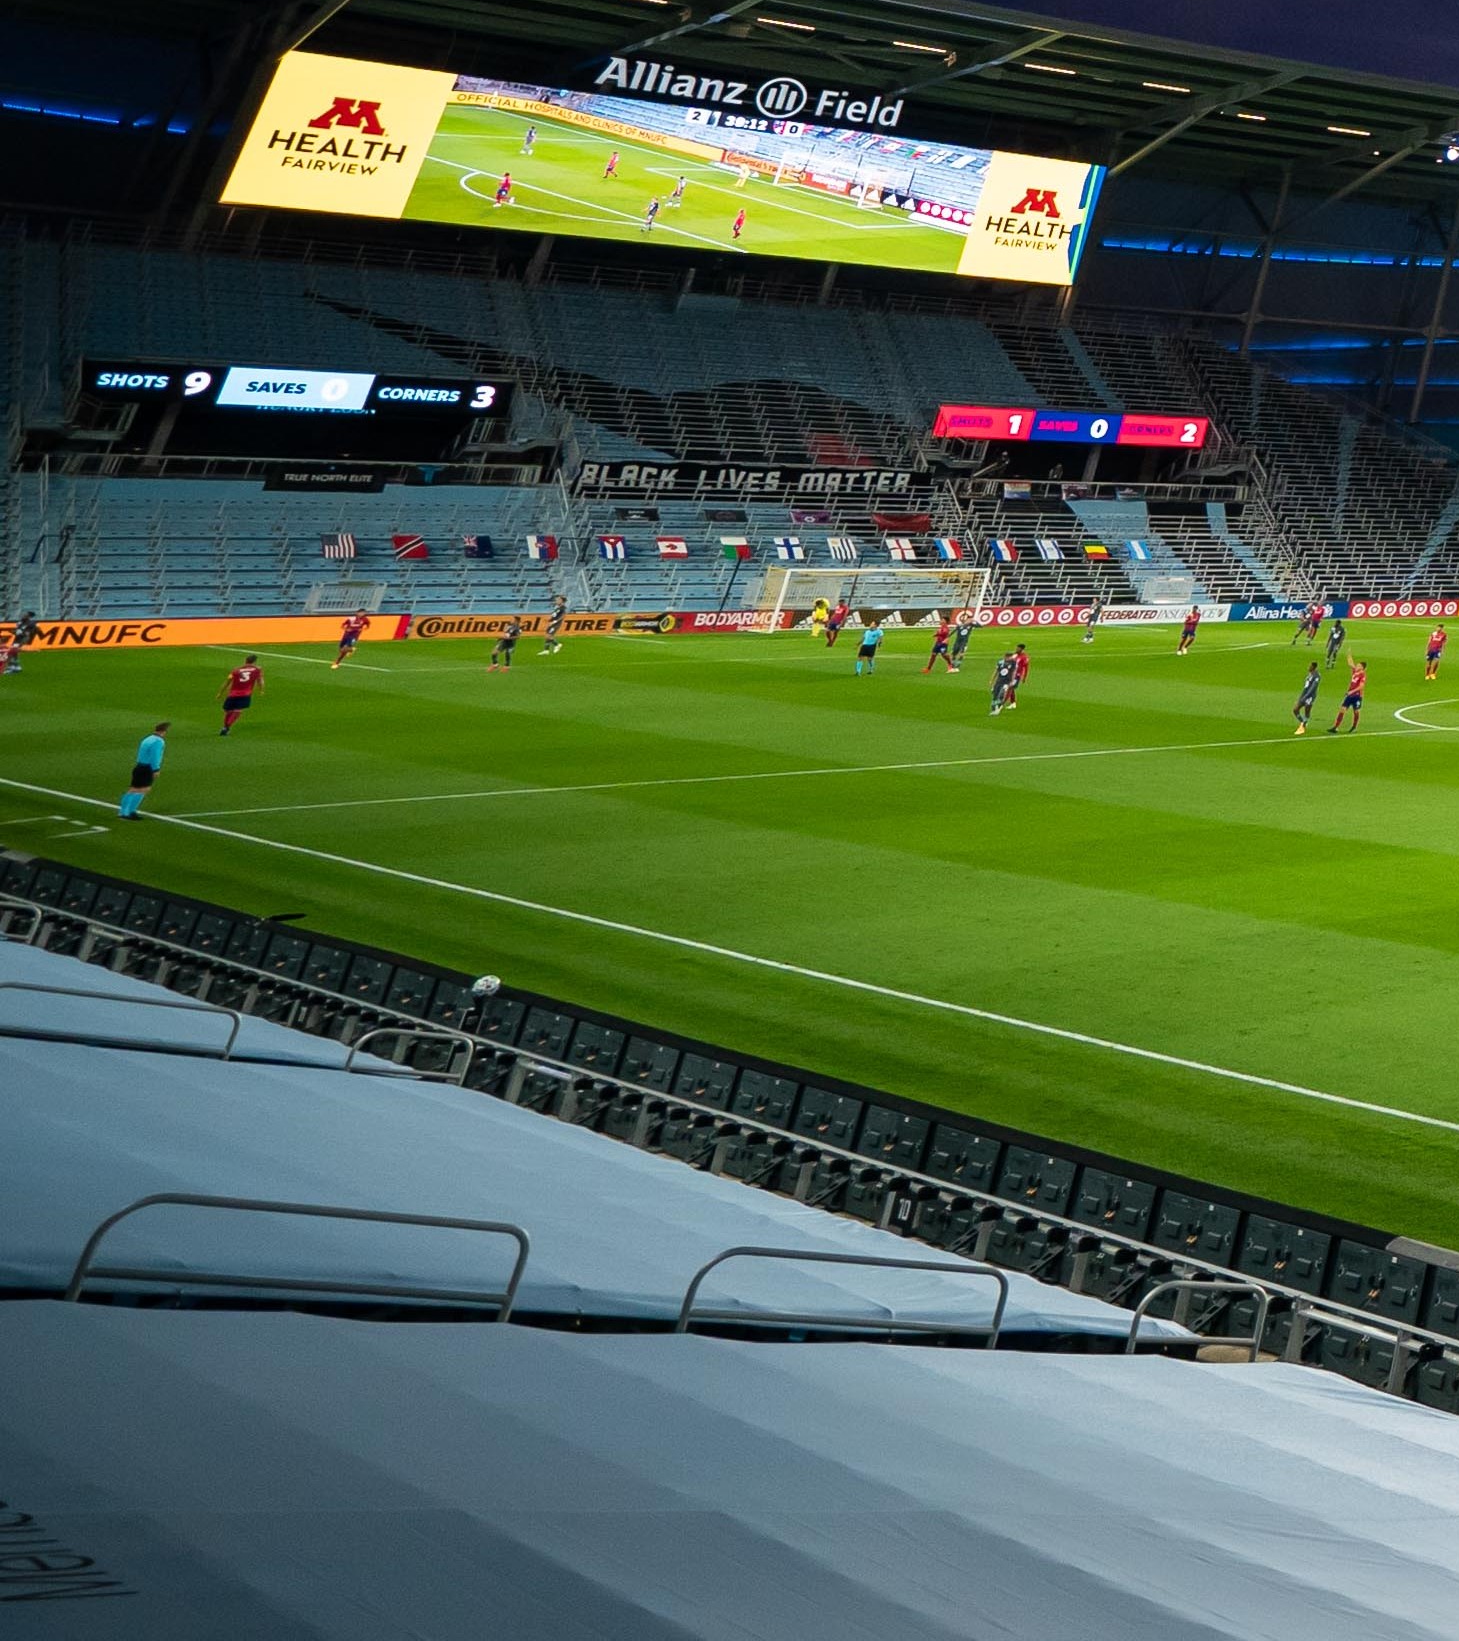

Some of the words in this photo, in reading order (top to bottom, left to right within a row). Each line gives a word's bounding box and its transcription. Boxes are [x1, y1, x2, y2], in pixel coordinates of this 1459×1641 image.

[594, 56, 748, 105] Allianz
[815, 89, 904, 127] Field
[456, 93, 520, 109] OFFICIAL
[525, 100, 572, 120] HOSPITALS
[574, 111, 592, 124] AND
[592, 117, 625, 133] CLINICS
[625, 124, 638, 135] OF
[639, 129, 667, 145] MNUFC
[789, 125, 798, 135] 0
[267, 130, 408, 163] HEALTH
[281, 156, 379, 176] FAIRVIEW
[985, 216, 1072, 240] HEALTH
[995, 237, 1058, 251] FAIRVIEW
[97, 373, 170, 389] SHOTS
[184, 371, 211, 396] 9
[245, 381, 308, 395] SAVES
[378, 387, 462, 402] CORNERS
[470, 385, 496, 408] 3
[1008, 414, 1023, 435] 1
[1090, 418, 1109, 439] 0
[1180, 423, 1199, 443] 2
[284, 473, 309, 482] TRUE
[311, 474, 348, 482] NORTH
[349, 474, 373, 483] ELITE
[581, 463, 680, 490] BLACK
[700, 468, 782, 492] LIVES
[800, 471, 912, 494] MATTER
[1101, 609, 1157, 621] FEDERATED
[1244, 606, 1281, 620] Allina
[564, 620, 607, 631] TIRE
